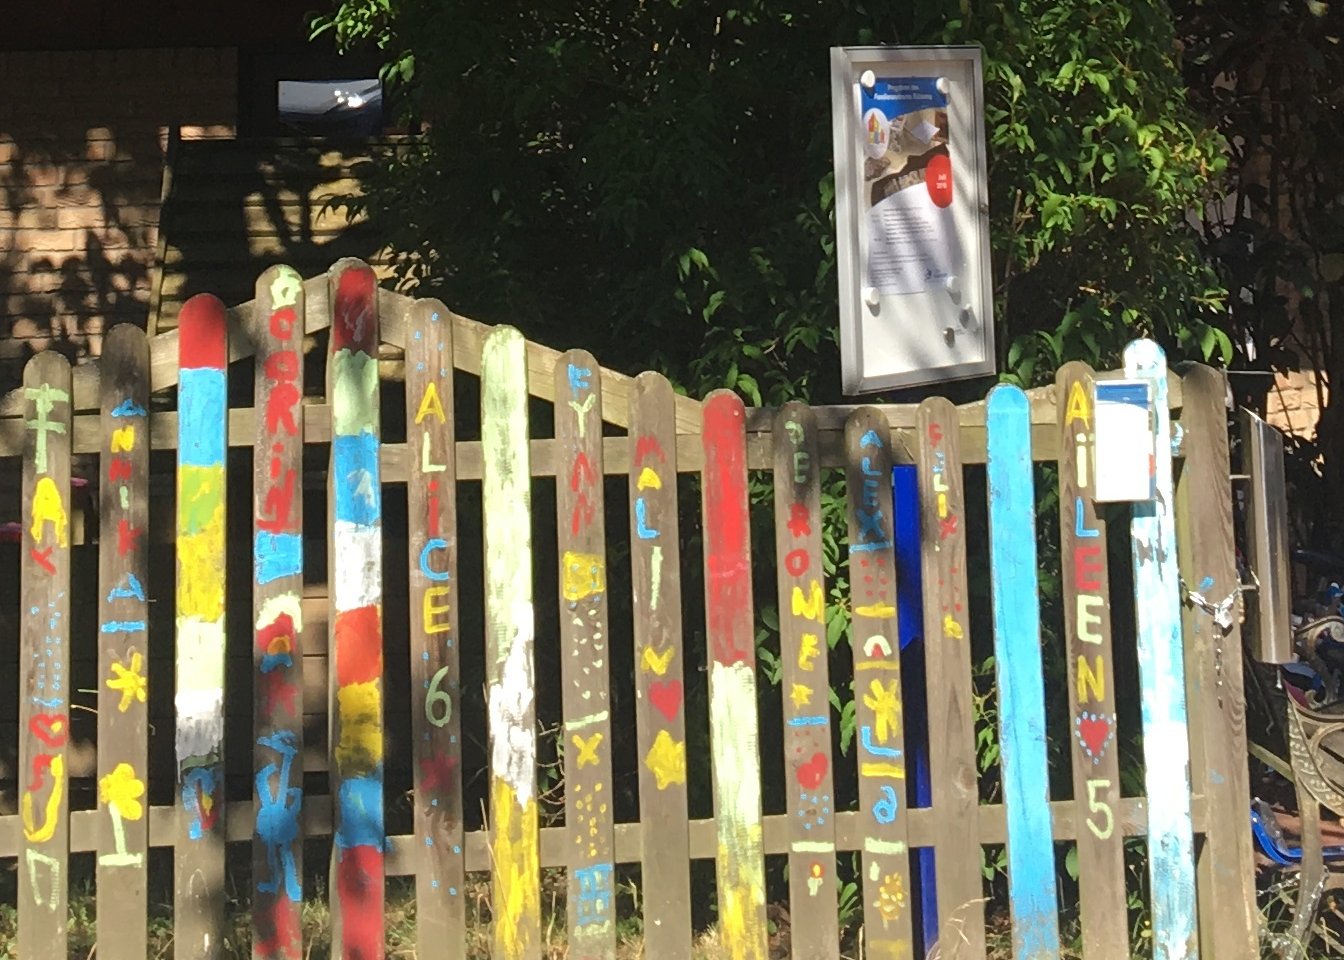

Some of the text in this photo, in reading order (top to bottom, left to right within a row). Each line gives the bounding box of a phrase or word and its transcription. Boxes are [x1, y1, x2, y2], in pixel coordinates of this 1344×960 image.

[415, 382, 451, 634] ALiCE
[425, 665, 452, 727] 6
[1085, 779, 1114, 840] 5
